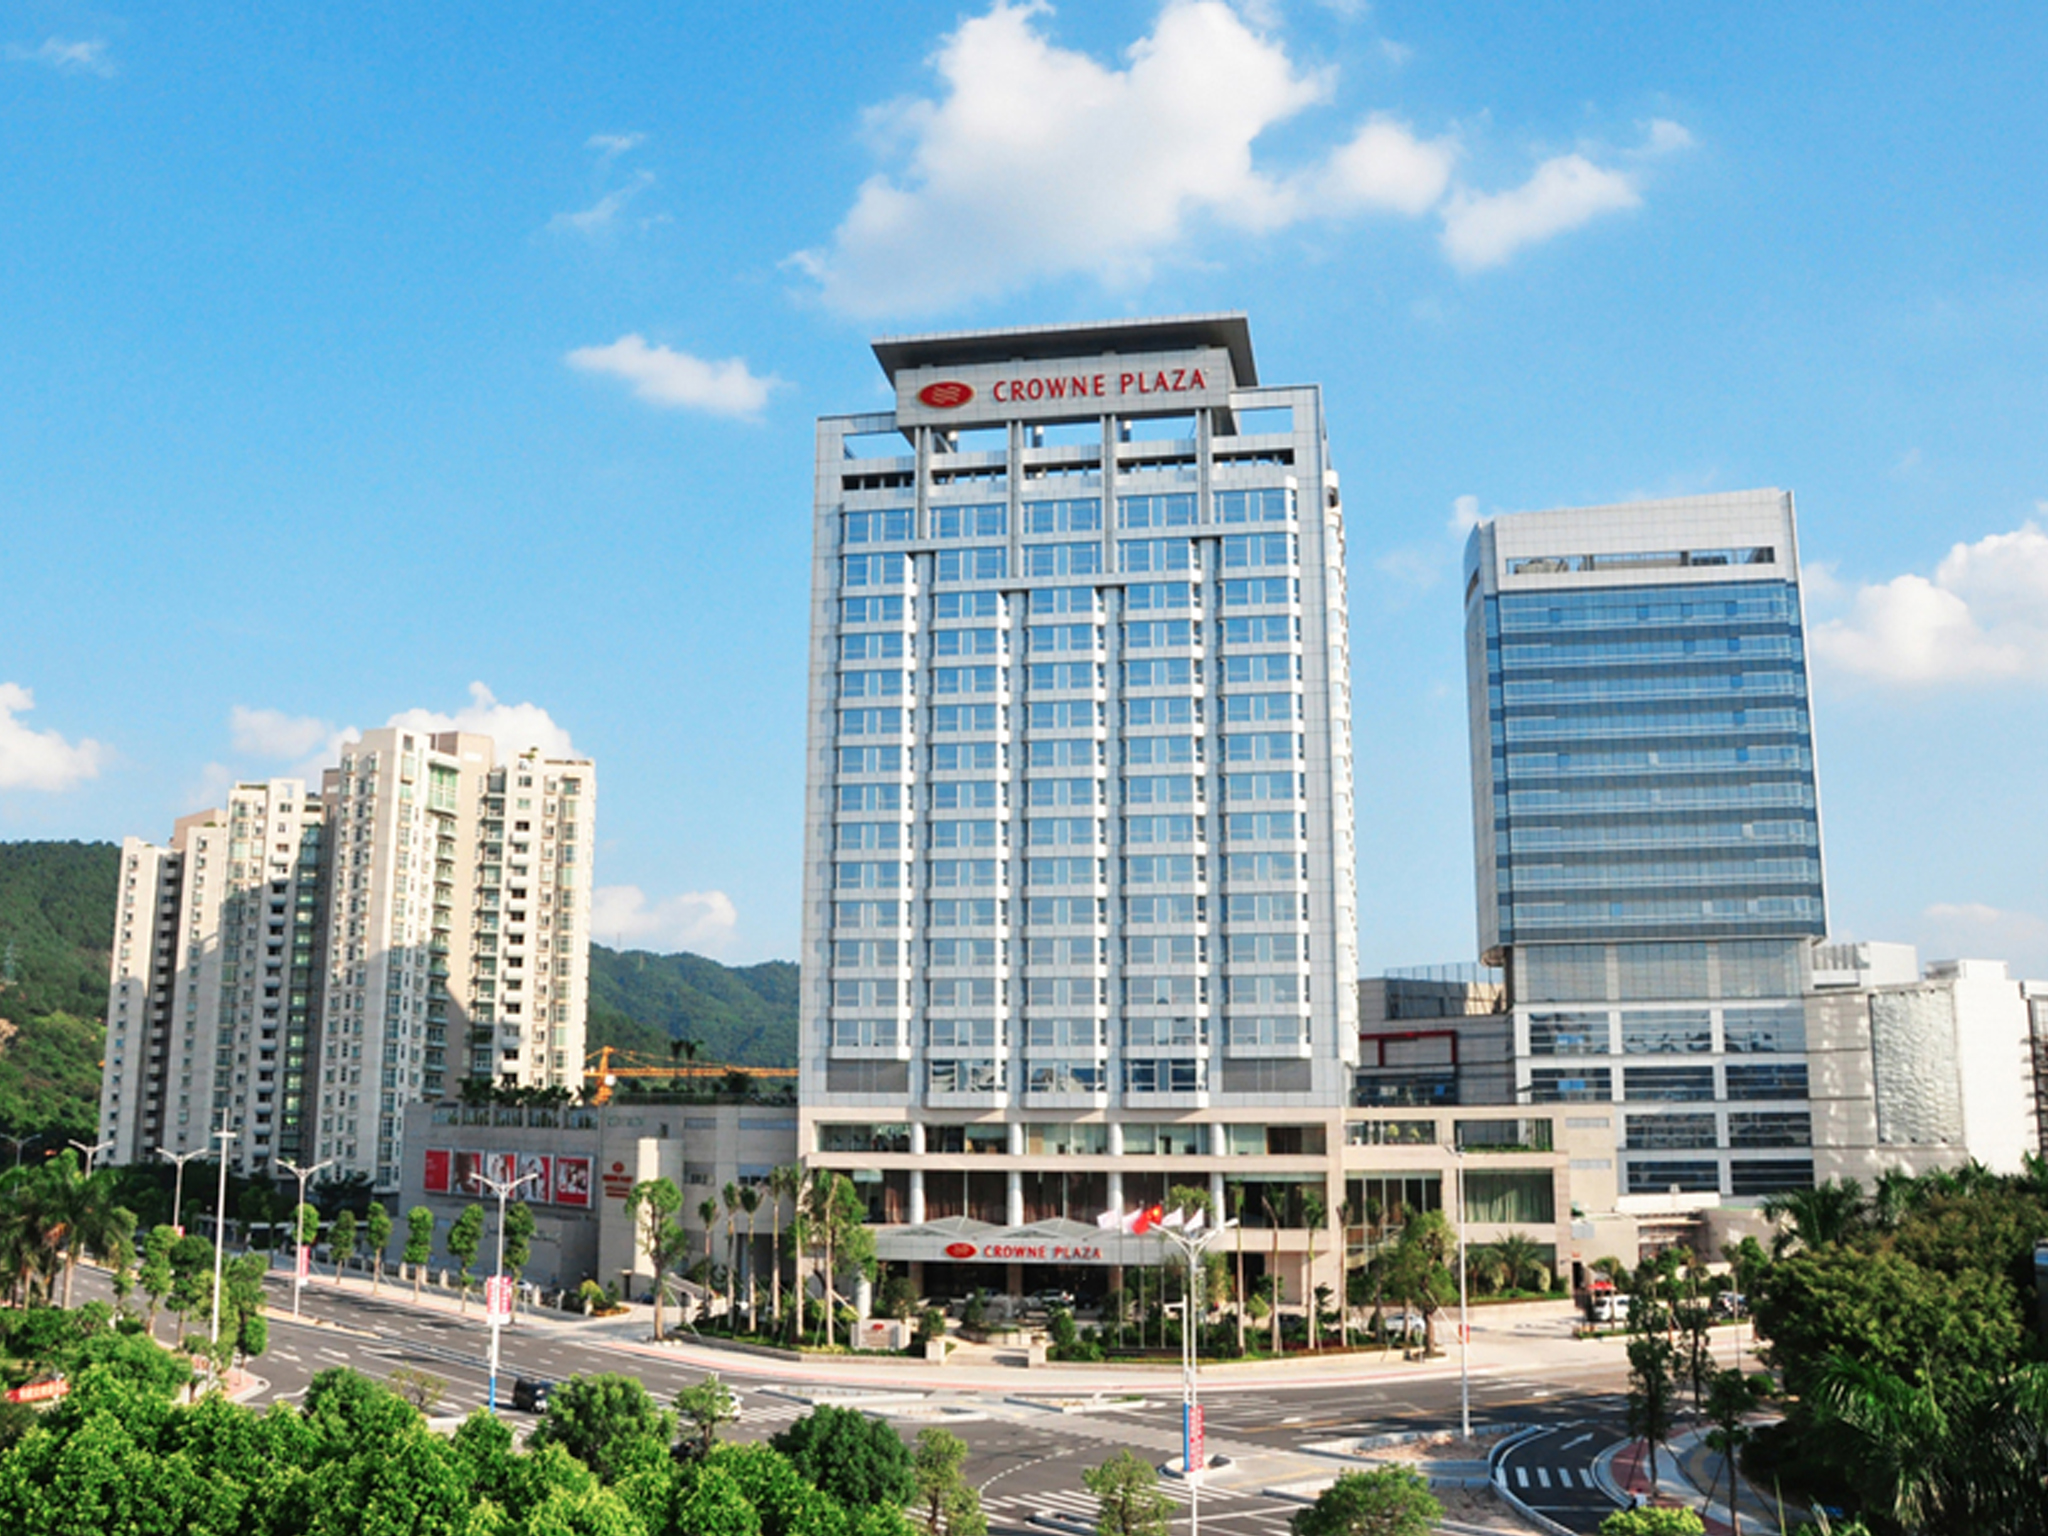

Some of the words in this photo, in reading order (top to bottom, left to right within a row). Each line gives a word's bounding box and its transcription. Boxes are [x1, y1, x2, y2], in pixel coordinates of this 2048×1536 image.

[993, 374, 1106, 402] CROWNE
[1120, 368, 1206, 395] PLAZA
[983, 1245, 1045, 1259] CROWNE
[1054, 1245, 1102, 1259] PLAZA
